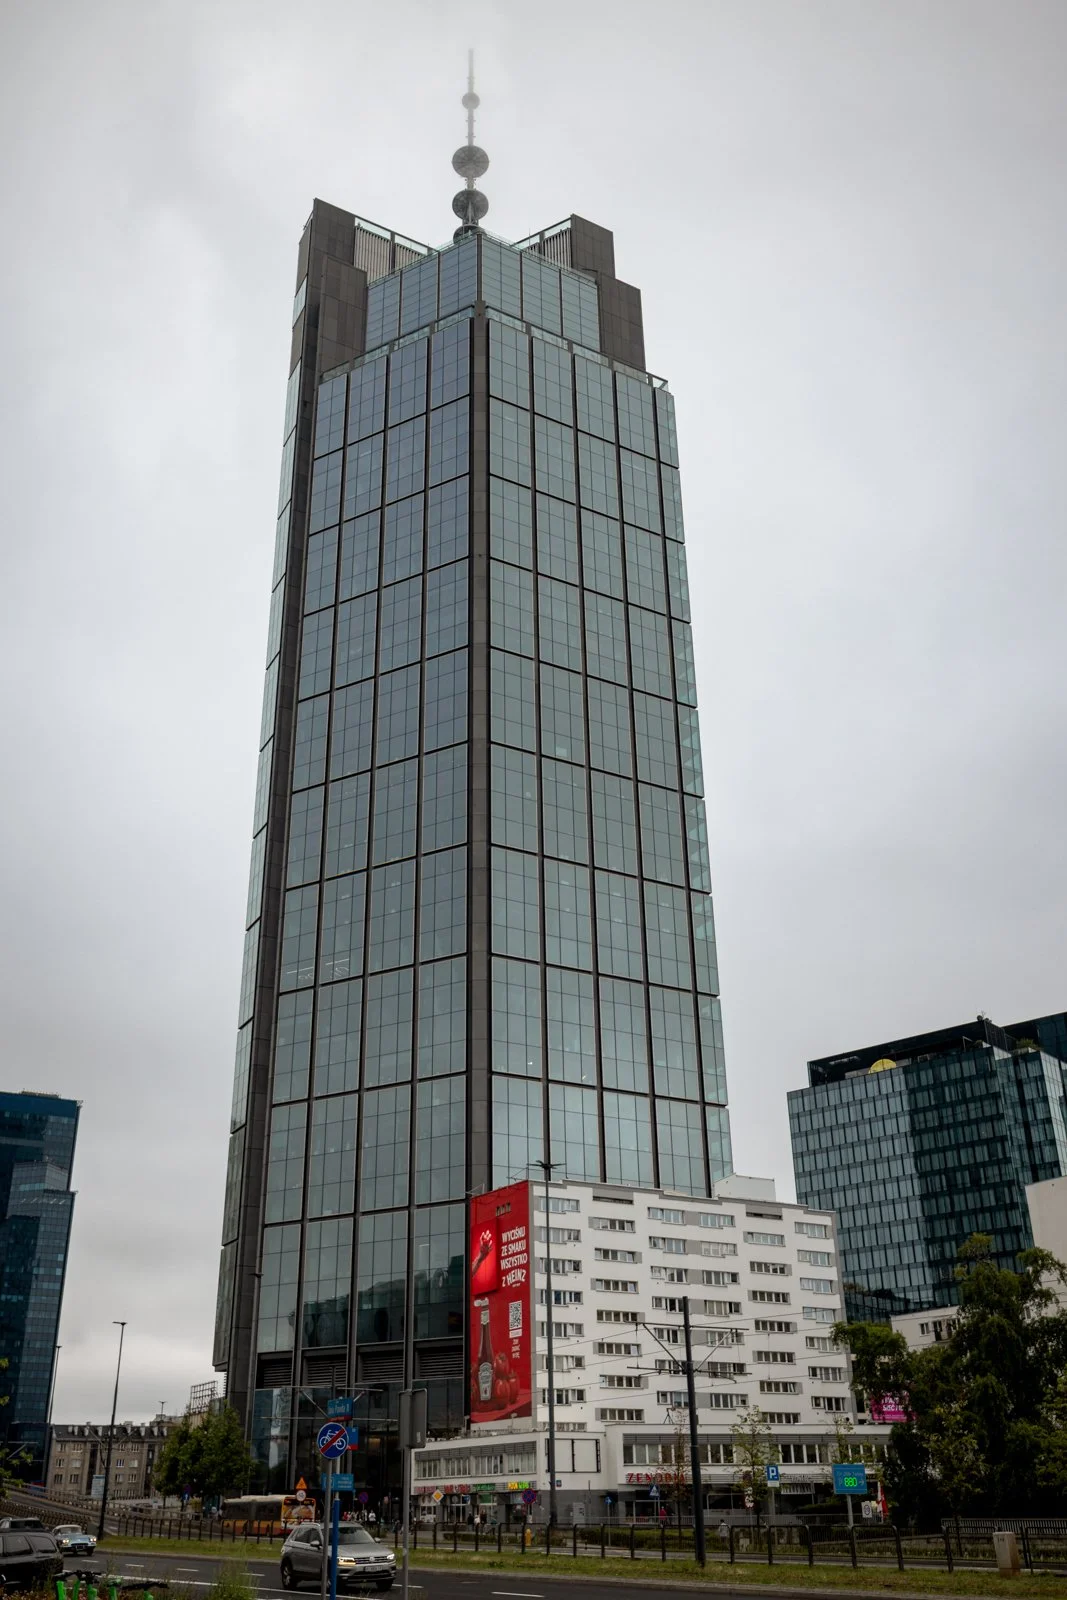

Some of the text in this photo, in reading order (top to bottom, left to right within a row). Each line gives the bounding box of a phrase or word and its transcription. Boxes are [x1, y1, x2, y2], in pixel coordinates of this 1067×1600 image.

[508, 1240, 526, 1255] SMAKU
[500, 1252, 528, 1270] WSZYSTKO
[506, 1268, 527, 1286] HEINZ
[768, 1467, 777, 1479] P
